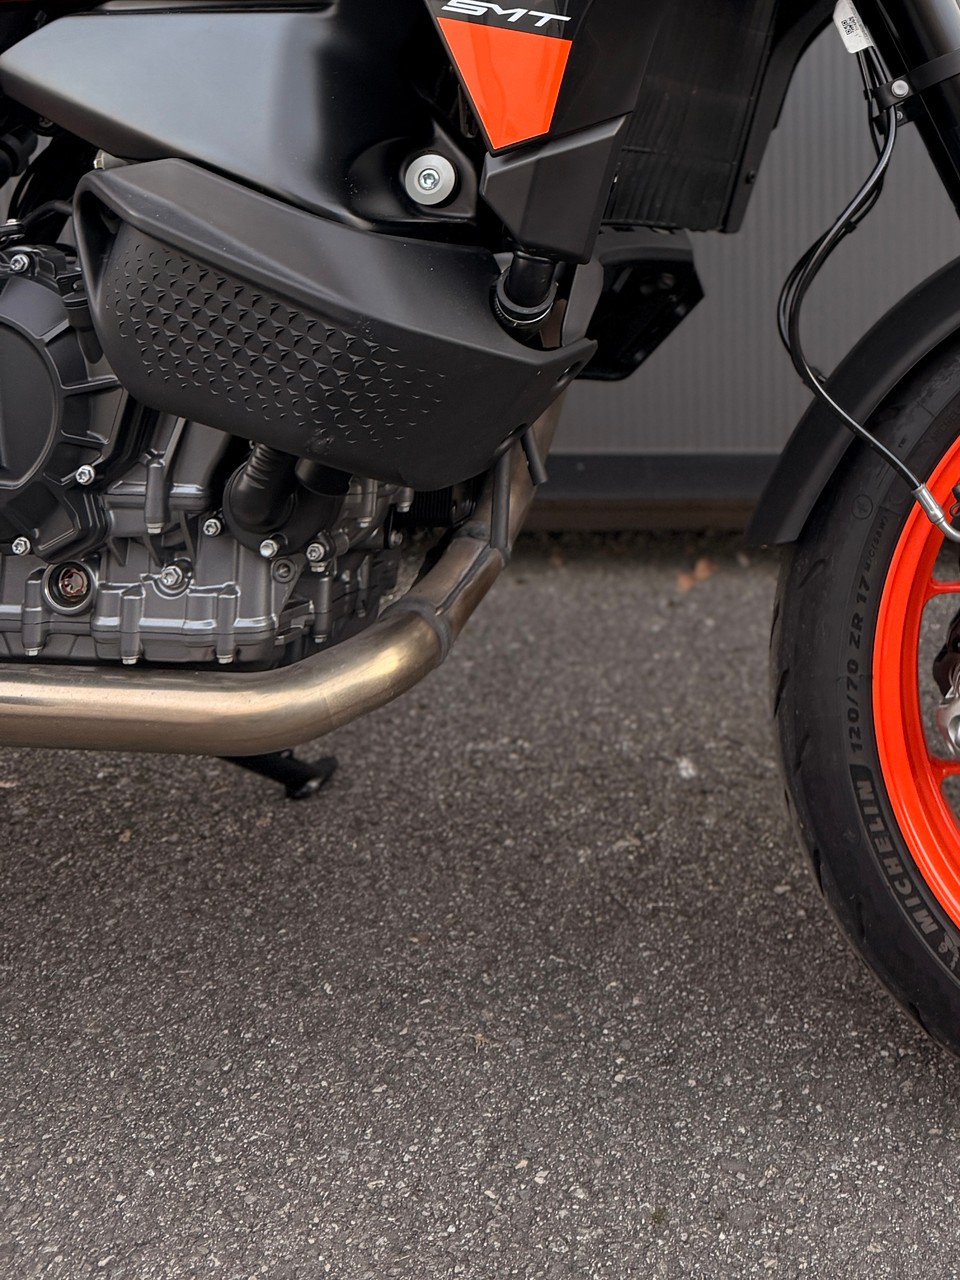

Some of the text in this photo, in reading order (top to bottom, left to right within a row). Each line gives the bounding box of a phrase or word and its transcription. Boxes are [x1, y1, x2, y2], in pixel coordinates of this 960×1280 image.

[855, 574, 871, 604] 17
[848, 612, 865, 649] ZR
[846, 657, 863, 753] 120/70
[857, 780, 936, 934] MICHELIN
